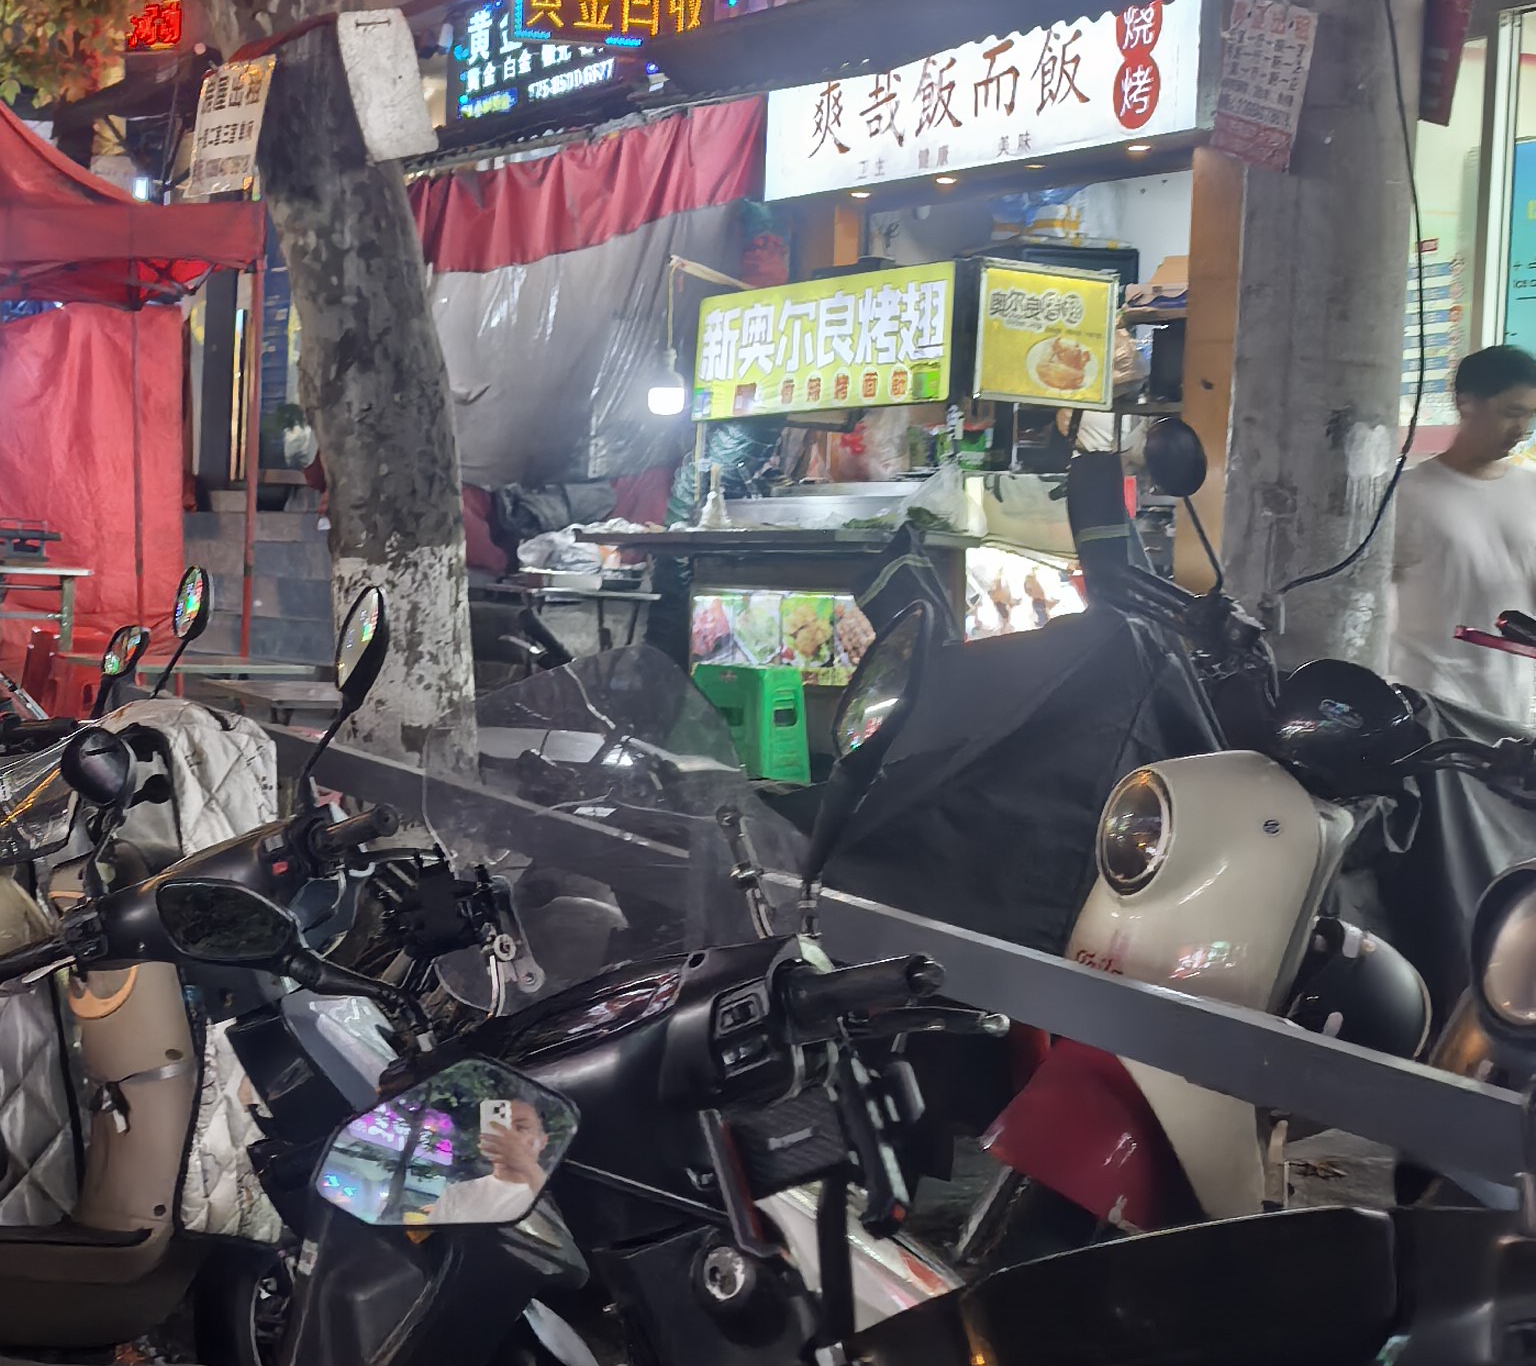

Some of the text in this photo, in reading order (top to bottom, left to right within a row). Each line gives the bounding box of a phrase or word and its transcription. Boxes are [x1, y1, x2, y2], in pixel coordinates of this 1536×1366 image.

[1120, 4, 1156, 118] 烧烤
[698, 279, 947, 382] 新奥尔良烤翅
